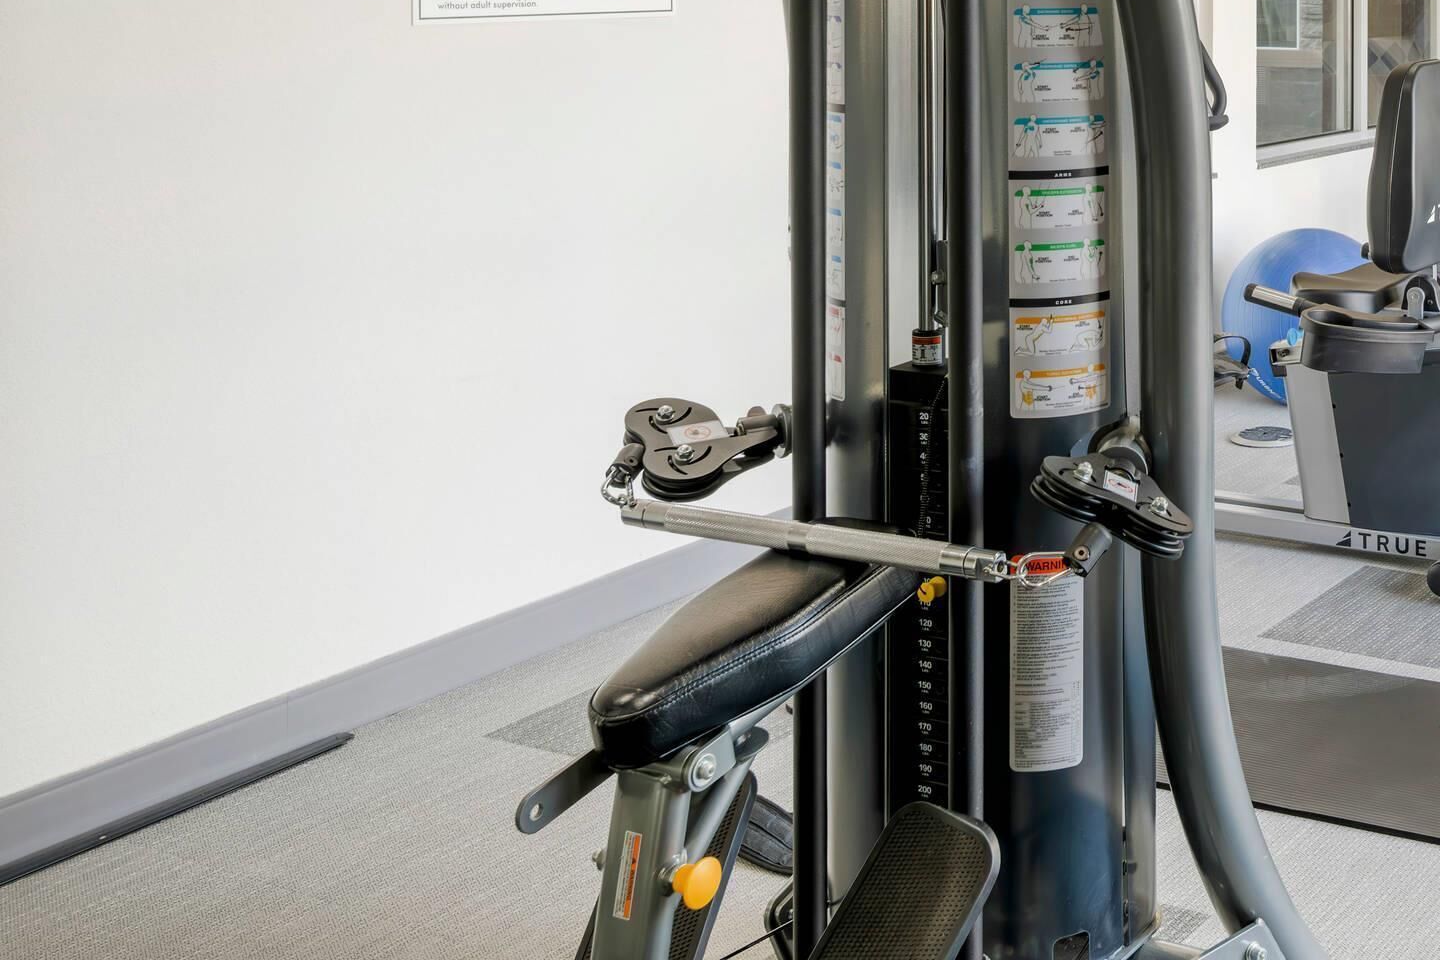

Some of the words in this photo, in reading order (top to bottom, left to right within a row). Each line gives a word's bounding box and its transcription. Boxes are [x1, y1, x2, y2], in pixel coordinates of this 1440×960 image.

[920, 412, 929, 420] 20
[1358, 532, 1427, 557] TRUE
[1026, 560, 1067, 571] WARNI
[919, 619, 932, 628] 120
[918, 639, 932, 648] 130
[918, 660, 932, 669] 140
[918, 681, 932, 690] 150
[919, 701, 932, 711] 160
[918, 722, 932, 731] 170
[919, 743, 932, 752] 180
[919, 764, 932, 773] 190
[918, 785, 932, 795] 200
